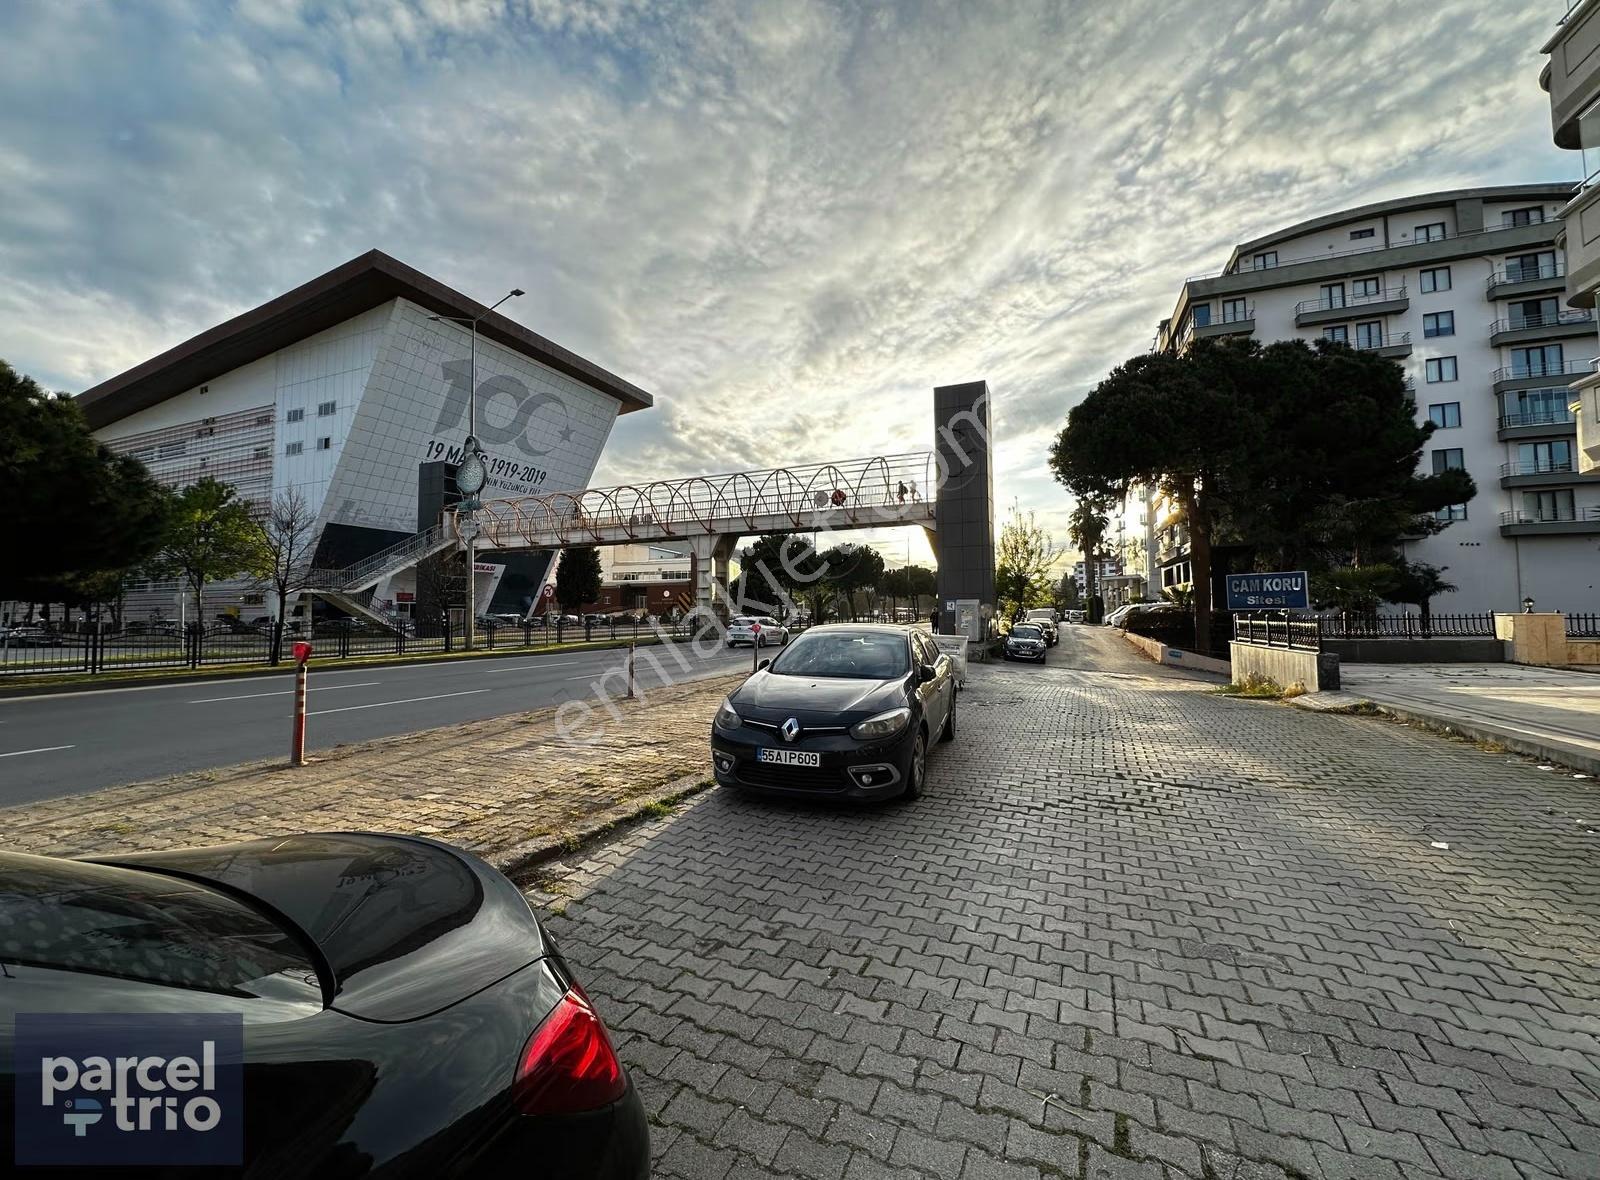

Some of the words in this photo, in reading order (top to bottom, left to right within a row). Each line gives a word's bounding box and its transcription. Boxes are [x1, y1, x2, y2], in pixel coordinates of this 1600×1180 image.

[426, 440, 445, 460] 19
[489, 458, 547, 485] 1919-2019
[1262, 577, 1302, 592] KORU
[1247, 595, 1286, 605] Sitesi
